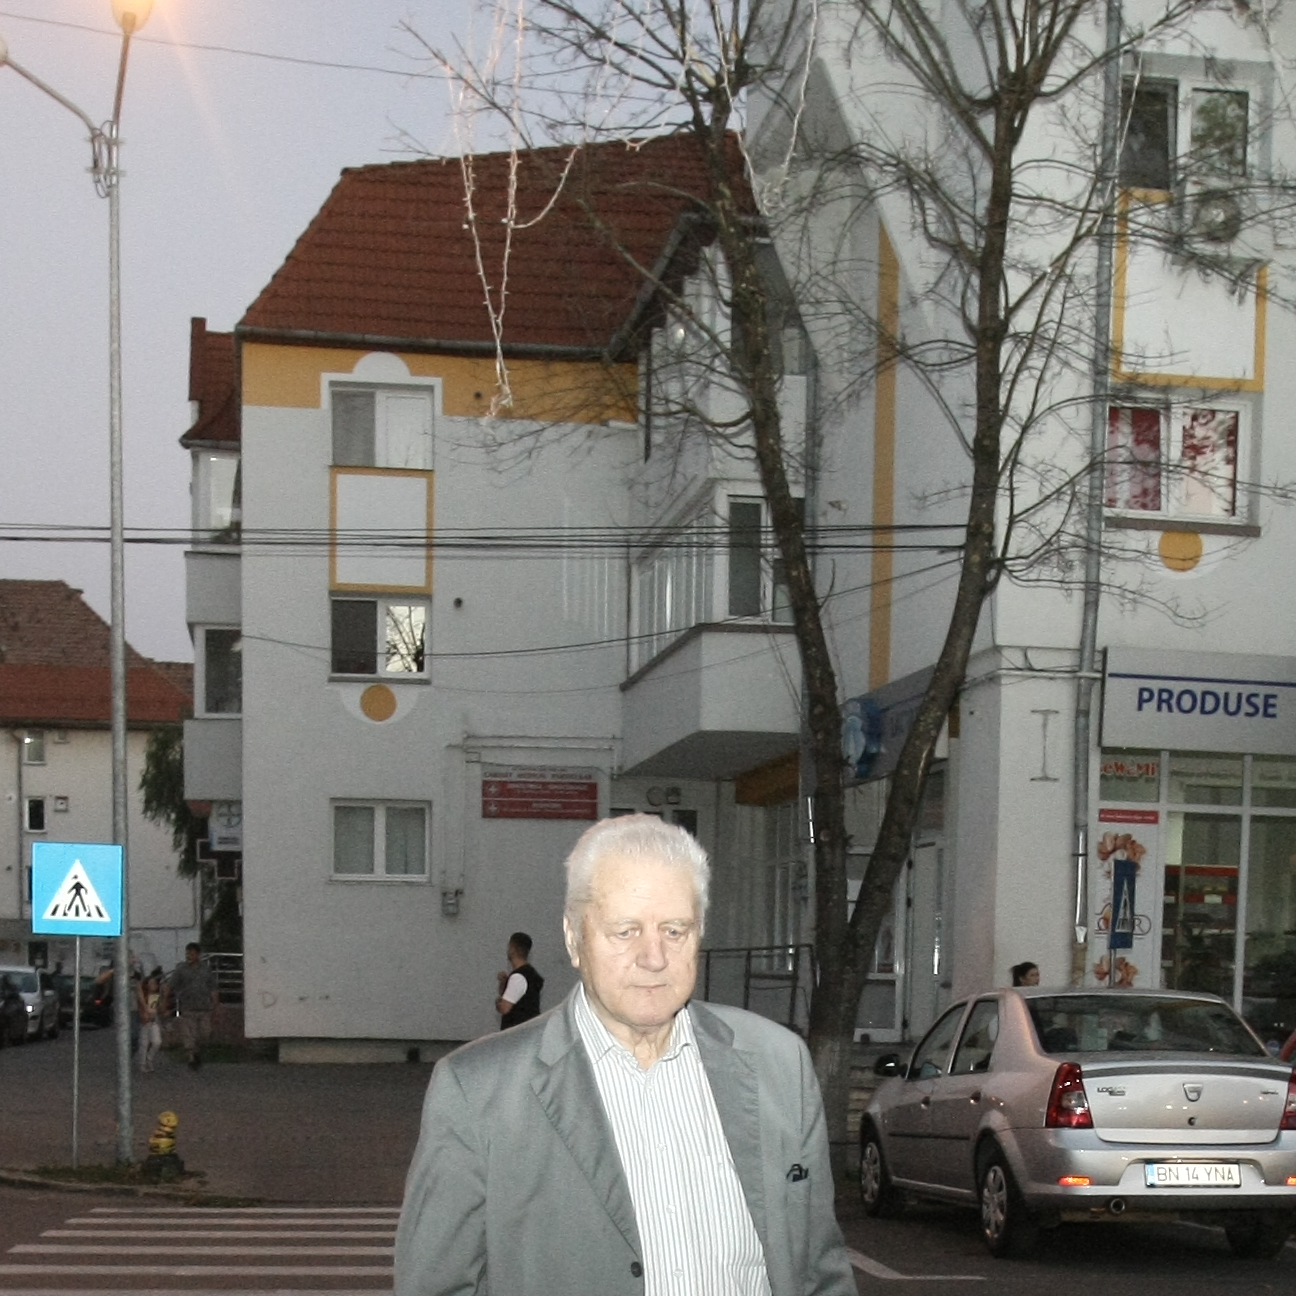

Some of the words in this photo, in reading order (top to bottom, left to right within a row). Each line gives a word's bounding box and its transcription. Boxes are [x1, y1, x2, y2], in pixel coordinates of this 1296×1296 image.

[1137, 687, 1279, 719] PRODUSE
[1157, 1165, 1180, 1182] BN
[1186, 1166, 1200, 1182] 14
[1203, 1166, 1235, 1182] YNA
